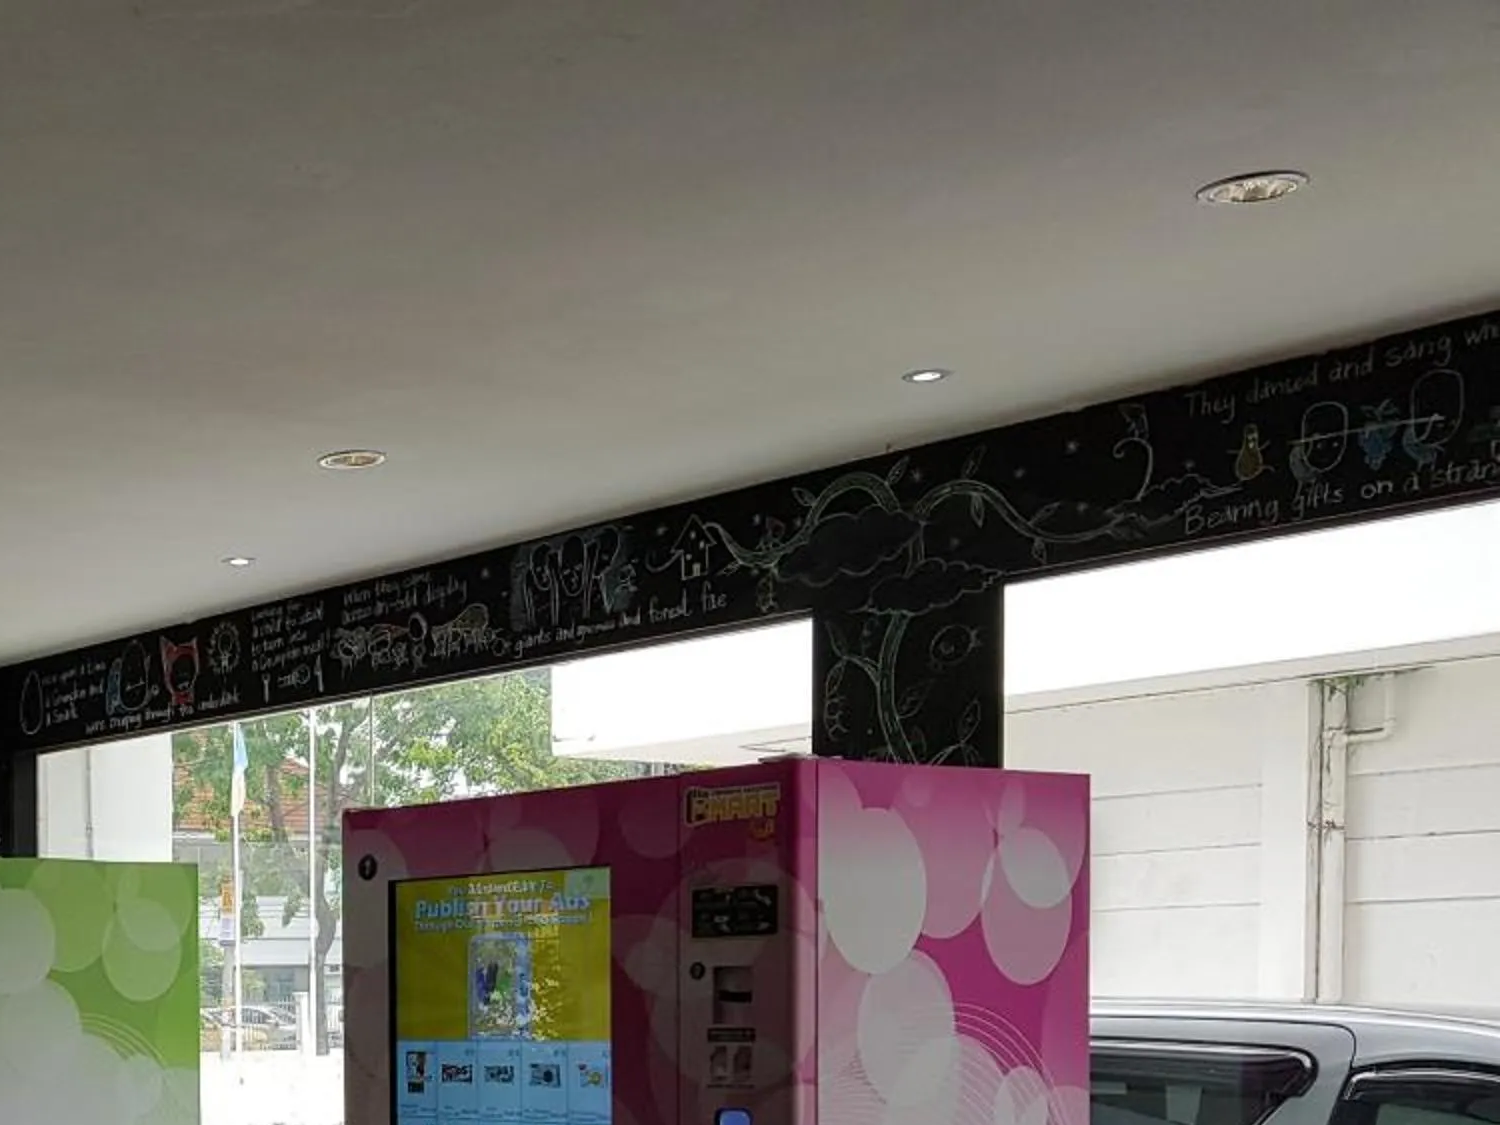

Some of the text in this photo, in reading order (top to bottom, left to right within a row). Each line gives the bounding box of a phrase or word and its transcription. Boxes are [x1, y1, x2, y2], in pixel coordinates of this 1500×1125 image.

[1184, 391, 1236, 424] They
[1328, 345, 1374, 382] and
[1385, 334, 1452, 367] sang
[1361, 479, 1394, 499] on
[1402, 471, 1420, 492] a
